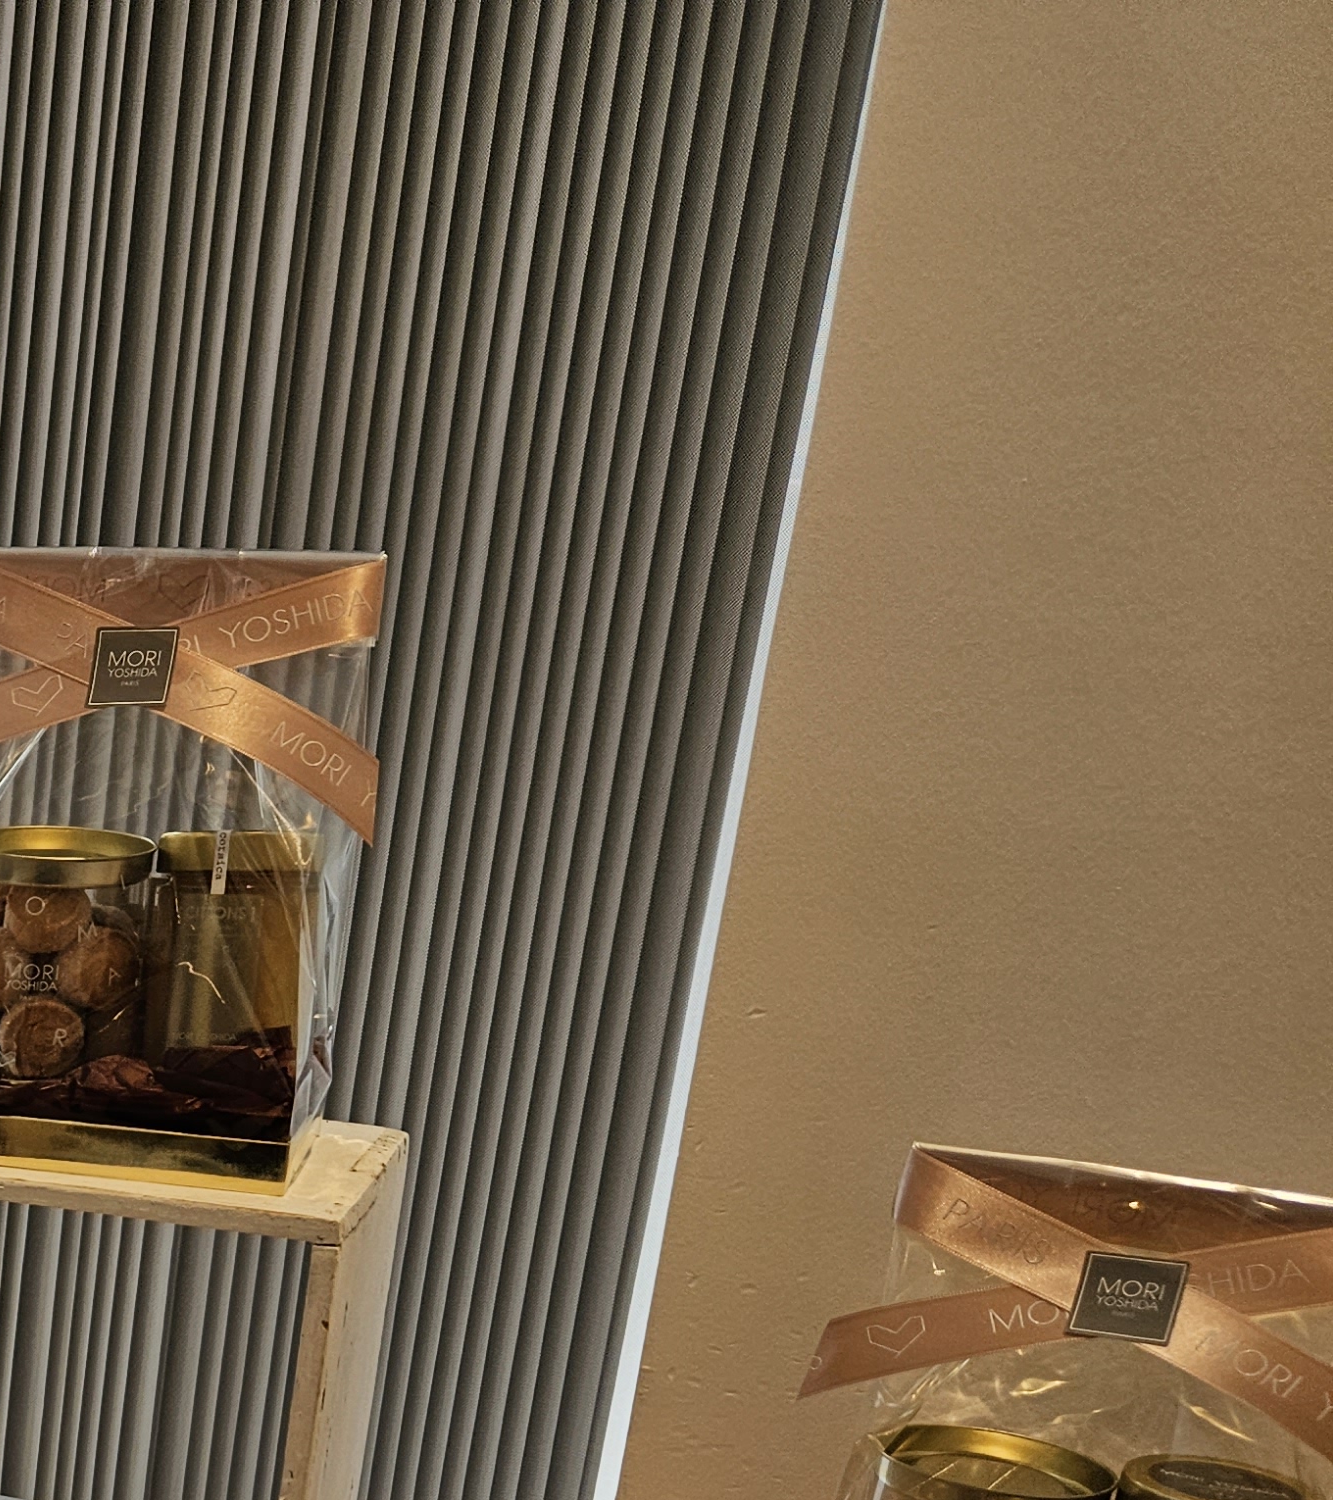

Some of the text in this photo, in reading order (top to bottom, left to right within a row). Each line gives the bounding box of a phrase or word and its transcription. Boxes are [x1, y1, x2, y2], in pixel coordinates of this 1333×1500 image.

[218, 588, 374, 649] YOSHIDA
[107, 650, 163, 668] MORI
[107, 667, 159, 679] YOSHIDA
[269, 720, 354, 787] MORI
[4, 963, 60, 982] MORI
[4, 979, 59, 992] YOSHIDA
[1096, 1276, 1167, 1301] MORI
[1095, 1295, 1160, 1312] YOSHIDA
